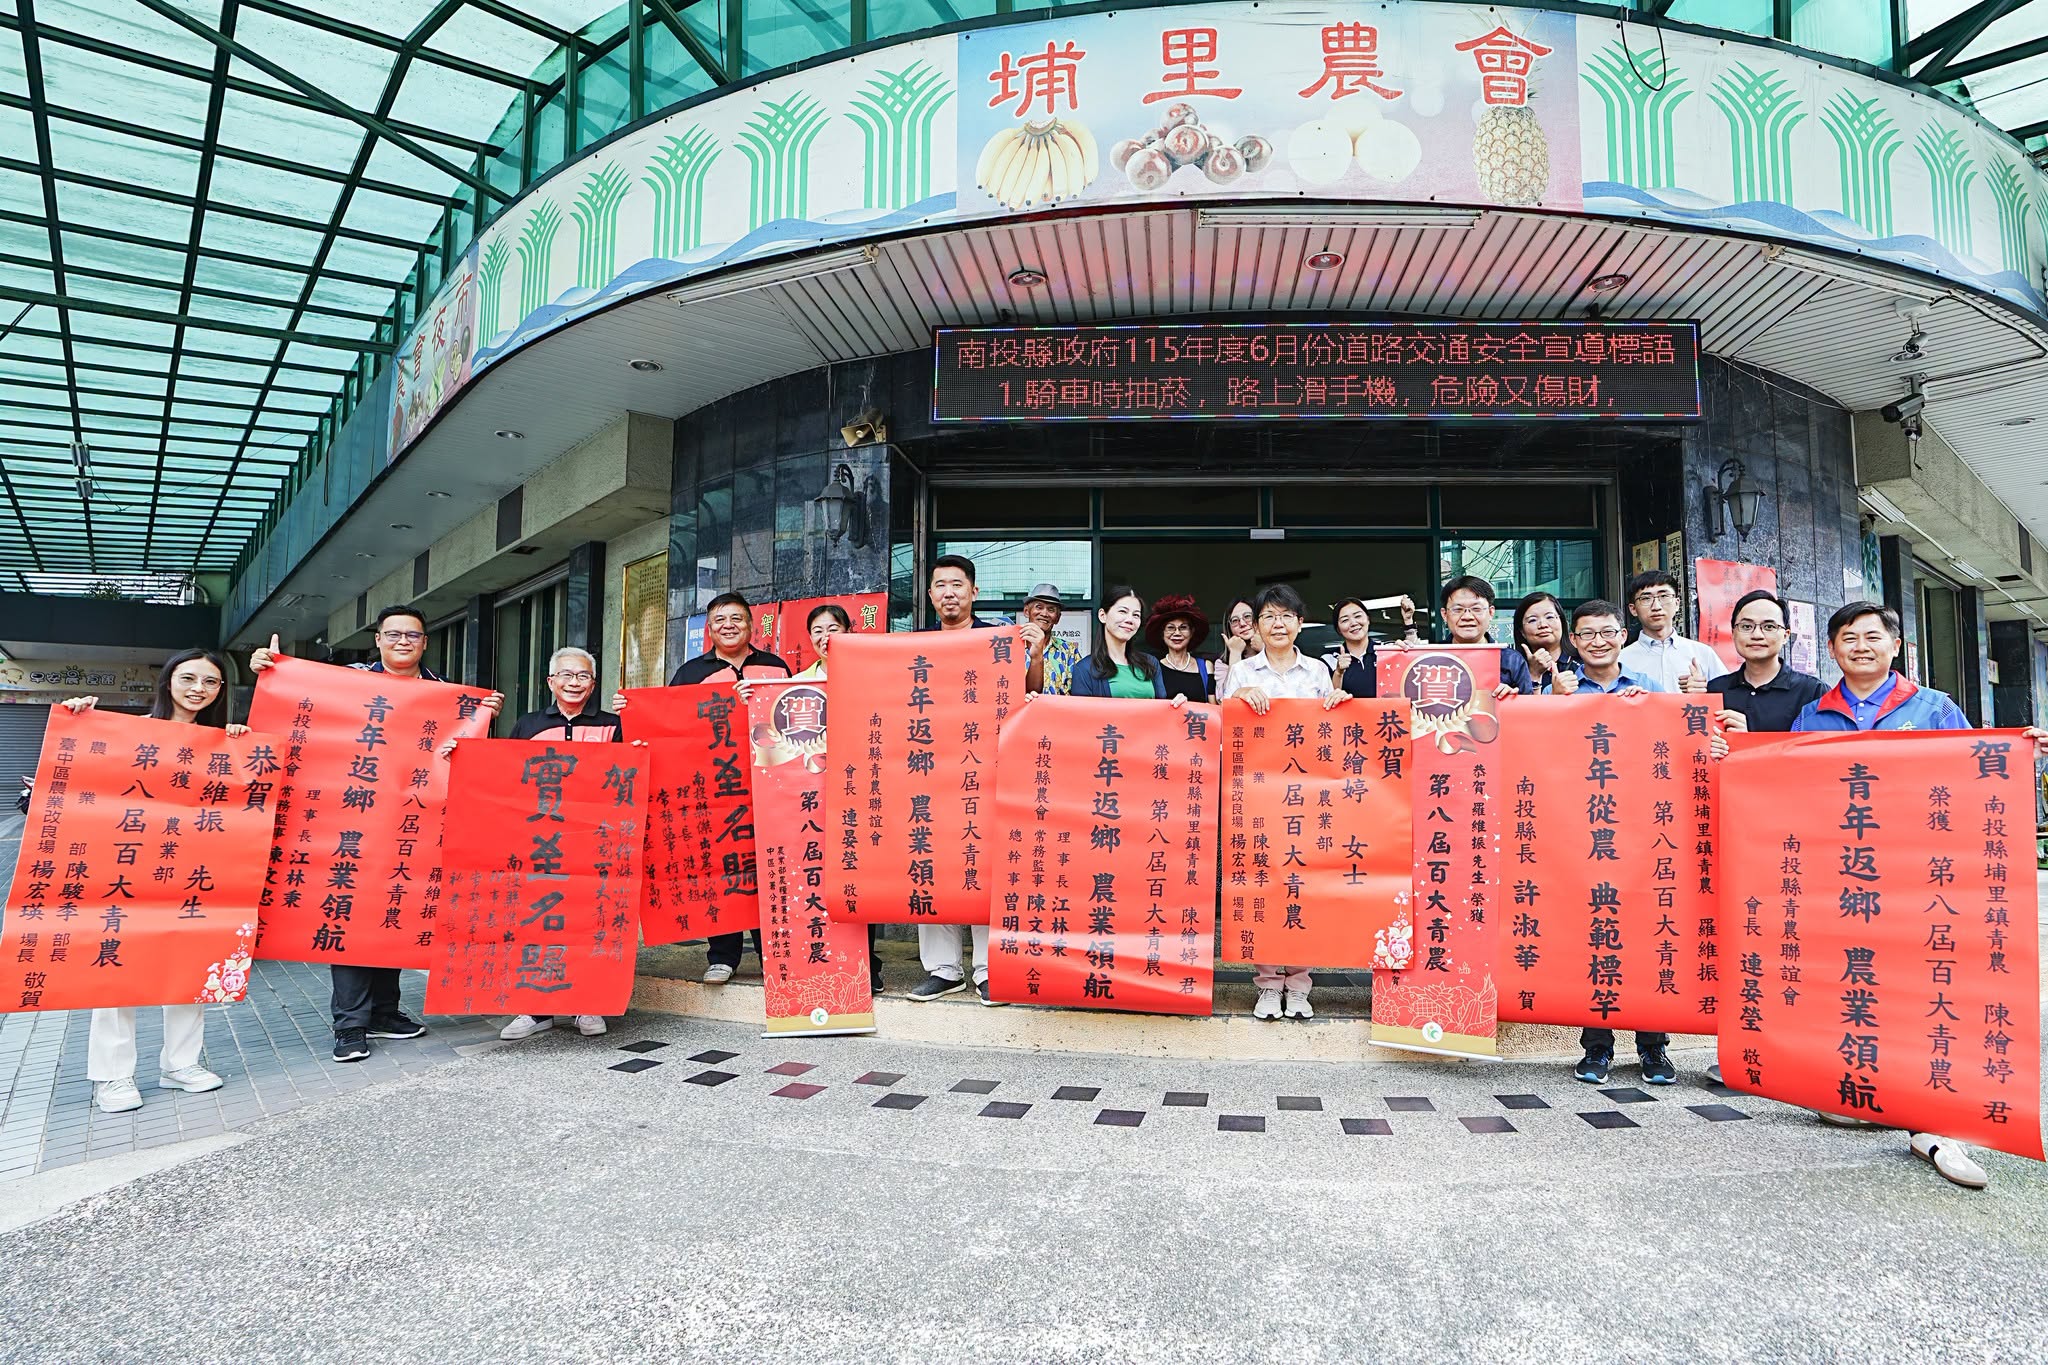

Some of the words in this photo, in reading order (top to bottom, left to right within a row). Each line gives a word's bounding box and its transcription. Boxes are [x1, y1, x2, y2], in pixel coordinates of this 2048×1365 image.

[988, 21, 1553, 118] 埔里農會
[957, 332, 1675, 369] 南投縣政府115年度6月份道路交通安全宣導標語
[761, 613, 774, 638] 賀
[860, 604, 878, 631] 賀
[989, 634, 1014, 665] 賀
[455, 693, 482, 723] 賀
[781, 696, 826, 735] 賀
[907, 654, 935, 777] 青年返鄉
[963, 669, 979, 704] 榮獲
[1413, 664, 1463, 710] 賀
[284, 697, 314, 778] 南投縣農會
[418, 720, 438, 753] 榮獲
[1182, 709, 1209, 742] 賀
[1316, 722, 1334, 763] 榮獲
[1374, 709, 1410, 780] 恭賀
[1681, 703, 1710, 737] 賀
[169, 747, 195, 790] 榮獲
[242, 745, 281, 813] 恭賀
[342, 695, 394, 813] 青年返鄉
[843, 763, 857, 796] 會長
[868, 712, 883, 847] 南投縣青農聯誼會
[1034, 735, 1052, 821] 南投縣農會
[1151, 744, 1170, 781] 榮獲
[1232, 727, 1244, 829] 臺中區農業改良場
[1252, 726, 1265, 829] 農業部
[1342, 722, 1369, 804] 陳繪婷
[1473, 764, 1486, 795] 恭賀
[1652, 741, 1672, 780] 榮獲
[1970, 740, 2012, 780] 賀
[37, 737, 77, 854] 臺中區農業改良場
[70, 741, 107, 856] 農業部
[194, 752, 233, 833] 羅維振
[602, 763, 638, 808] 賀
[960, 721, 983, 892] 第八屆百大青農
[1090, 723, 1125, 855] 青年返鄉
[1584, 722, 1621, 861] 青年從農
[1926, 785, 1952, 832] 榮獲
[299, 789, 321, 843] 理事長
[841, 808, 859, 871] 連晏瑩
[1184, 752, 1204, 886] 南投縣埔里鎮青農
[1282, 723, 1308, 930] 第八屆百大青農
[1316, 789, 1334, 853] 農業部
[1514, 775, 1537, 864] 南投縣長
[1692, 748, 1714, 895] 南投縣埔里鎮青農
[1838, 763, 1882, 924] 青年返鄉
[91, 743, 160, 967] 第八屆百大青農
[152, 816, 182, 884] 農業部
[380, 768, 430, 929] 第八屆百大青農
[800, 790, 830, 965] 第八屆百大青農
[907, 794, 938, 917] 農業領航
[1007, 828, 1023, 886] 總幹事
[1031, 828, 1048, 888] 常務監事
[1055, 831, 1071, 889] 理事長
[1230, 833, 1247, 886] 楊宏瑛
[1252, 835, 1271, 888] 陳駿季
[1342, 835, 1369, 886] 女士
[1424, 773, 1454, 973] 第八屆百大青農
[19, 860, 56, 921] 楊宏瑛
[56, 862, 90, 922] 陳駿季
[178, 864, 214, 919] 先生
[281, 850, 310, 908] 江林秉
[311, 830, 364, 952] 農業領航
[843, 883, 858, 914] 敬賀
[1143, 798, 1171, 977] 第八屆百大青農
[1232, 896, 1245, 922] 場長
[1471, 893, 1486, 924] 榮獲
[1651, 801, 1681, 995] 第八屆百大青農
[1981, 795, 2010, 975] 南投縣埔里鎮青農
[415, 931, 434, 946] 君
[675, 914, 691, 932] 賀
[999, 892, 1020, 956] 曾明瑞
[1024, 893, 1047, 958] 陳文忠
[1050, 896, 1071, 958] 江林秉
[1082, 872, 1122, 1000] 農業領航
[1179, 907, 1200, 966] 陳繪婷
[1252, 897, 1265, 923] 部長
[1512, 879, 1541, 972] 許淑華
[1743, 896, 1762, 937] 會長
[1780, 833, 1803, 1007] 南投縣青農聯誼會
[17, 932, 38, 963] 場長
[50, 932, 70, 962] 部長
[1240, 929, 1254, 961] 敬賀
[1587, 881, 1624, 1021] 典範標竿
[1697, 918, 1719, 982] 羅維振
[1924, 856, 1960, 1093] 第八屆百大青農
[19, 972, 46, 1007] 敬賀
[1179, 977, 1197, 995] 君
[1518, 989, 1536, 1011] 賀
[1698, 996, 1719, 1015] 君
[1740, 952, 1764, 1033] 連晏瑩
[1836, 946, 1884, 1114] 農業領航
[1982, 1002, 2015, 1084] 陳繪婷
[1742, 1048, 1763, 1088] 敬賀
[1982, 1100, 2013, 1124] 君
